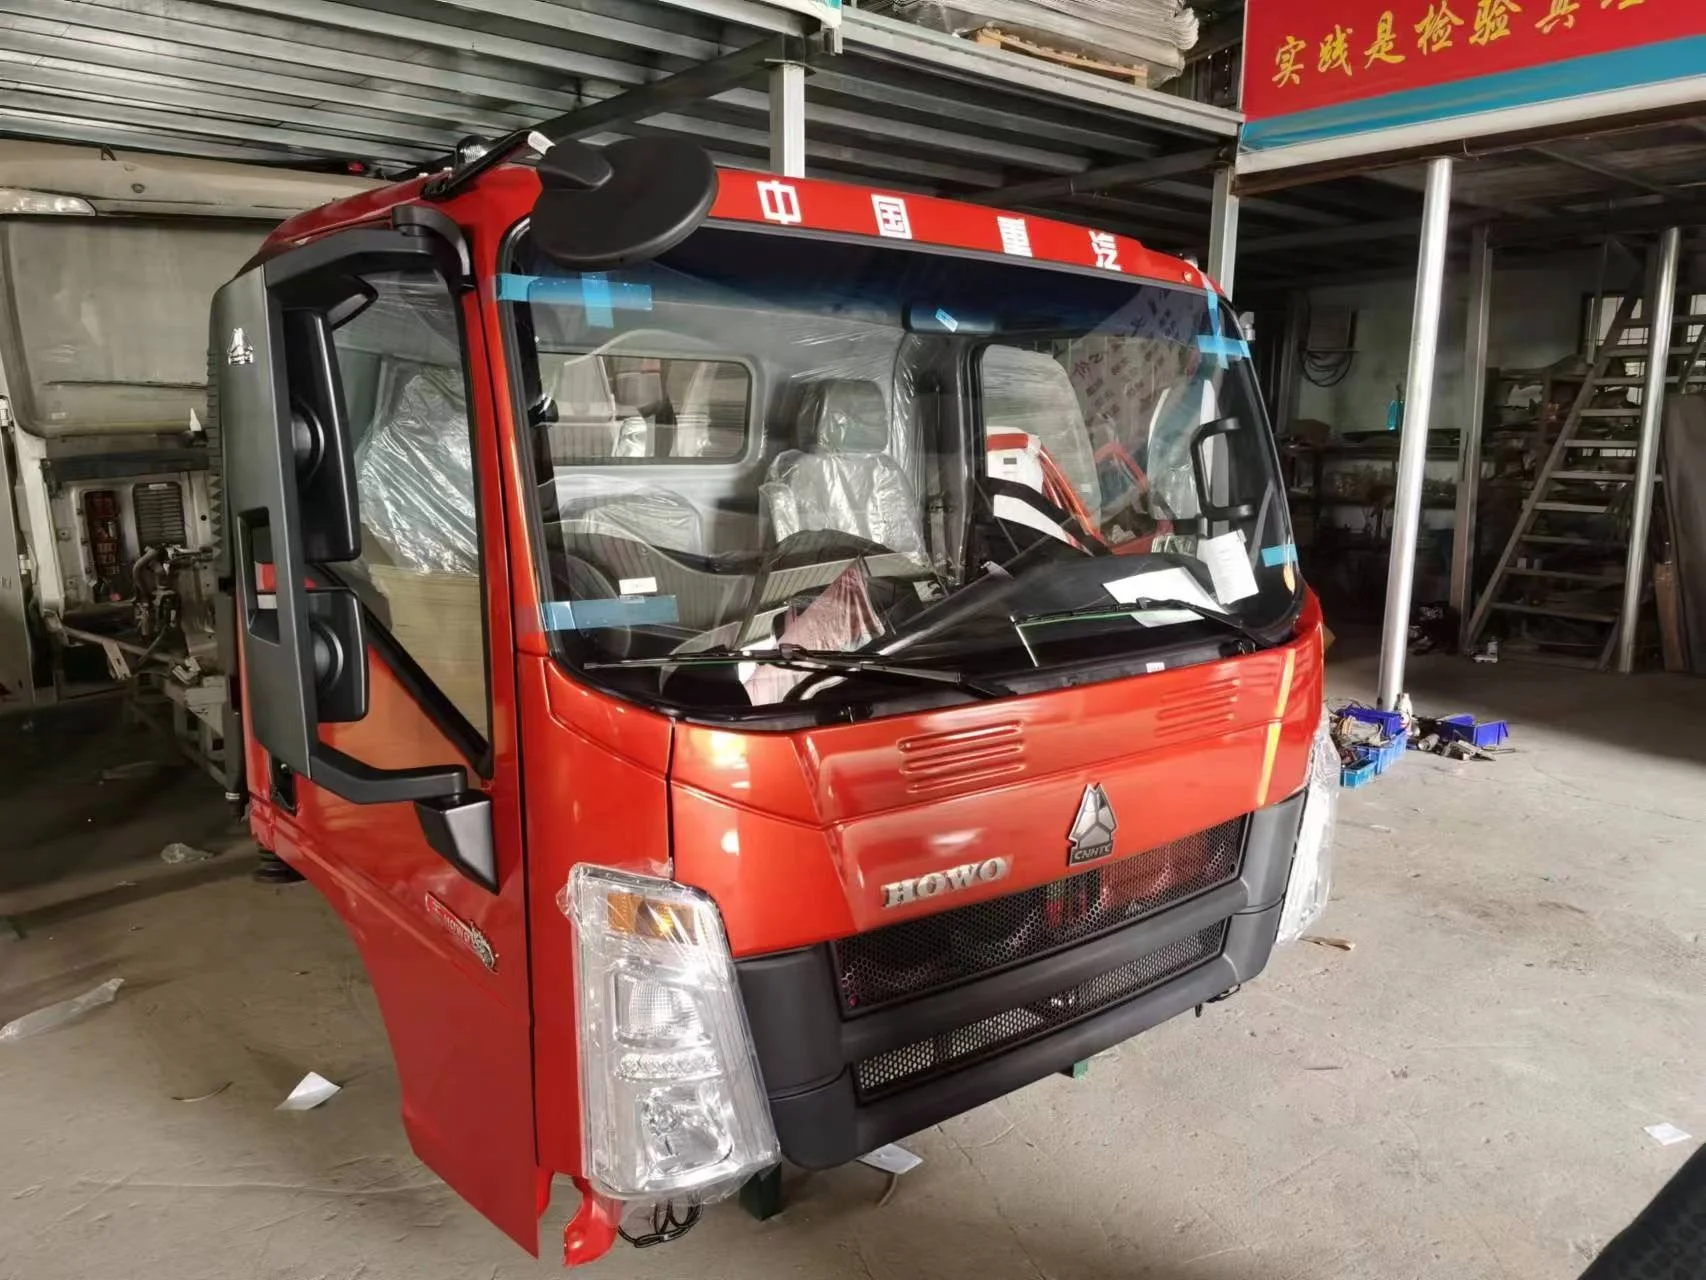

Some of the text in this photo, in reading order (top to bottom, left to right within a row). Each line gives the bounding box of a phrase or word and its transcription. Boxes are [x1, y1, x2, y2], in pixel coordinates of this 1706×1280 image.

[1272, 0, 1644, 88] 实践是检验真
[757, 180, 1121, 271] 中国重汽
[881, 856, 1008, 908] HOWO
